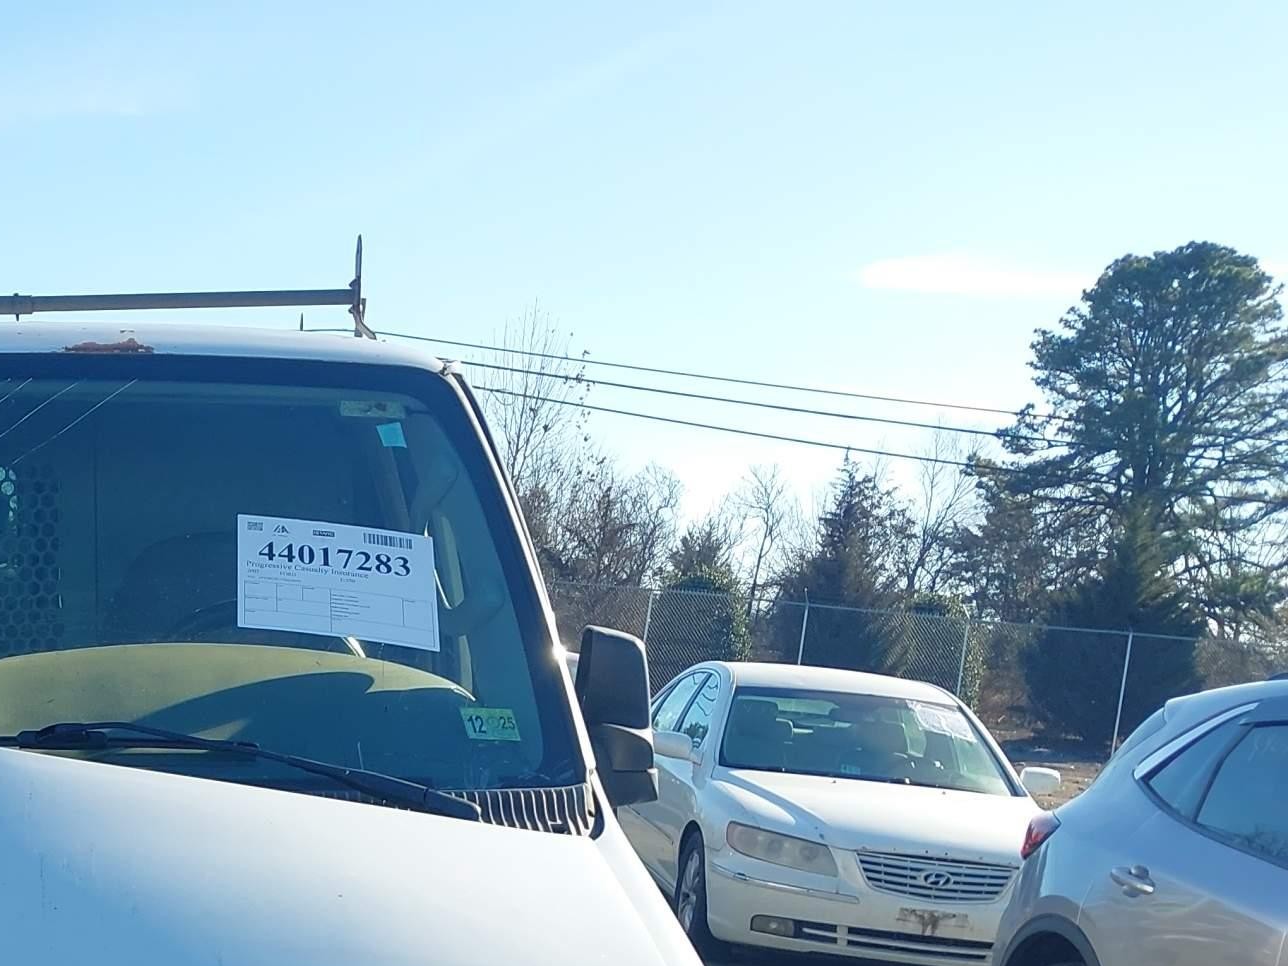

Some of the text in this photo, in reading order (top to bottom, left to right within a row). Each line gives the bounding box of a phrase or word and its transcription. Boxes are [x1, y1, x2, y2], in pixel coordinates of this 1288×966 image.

[258, 541, 411, 577] 44017283
[246, 560, 292, 570] Progressive
[294, 565, 329, 575] Casualty
[331, 569, 369, 579] Insurance
[467, 715, 515, 734] 12 25
